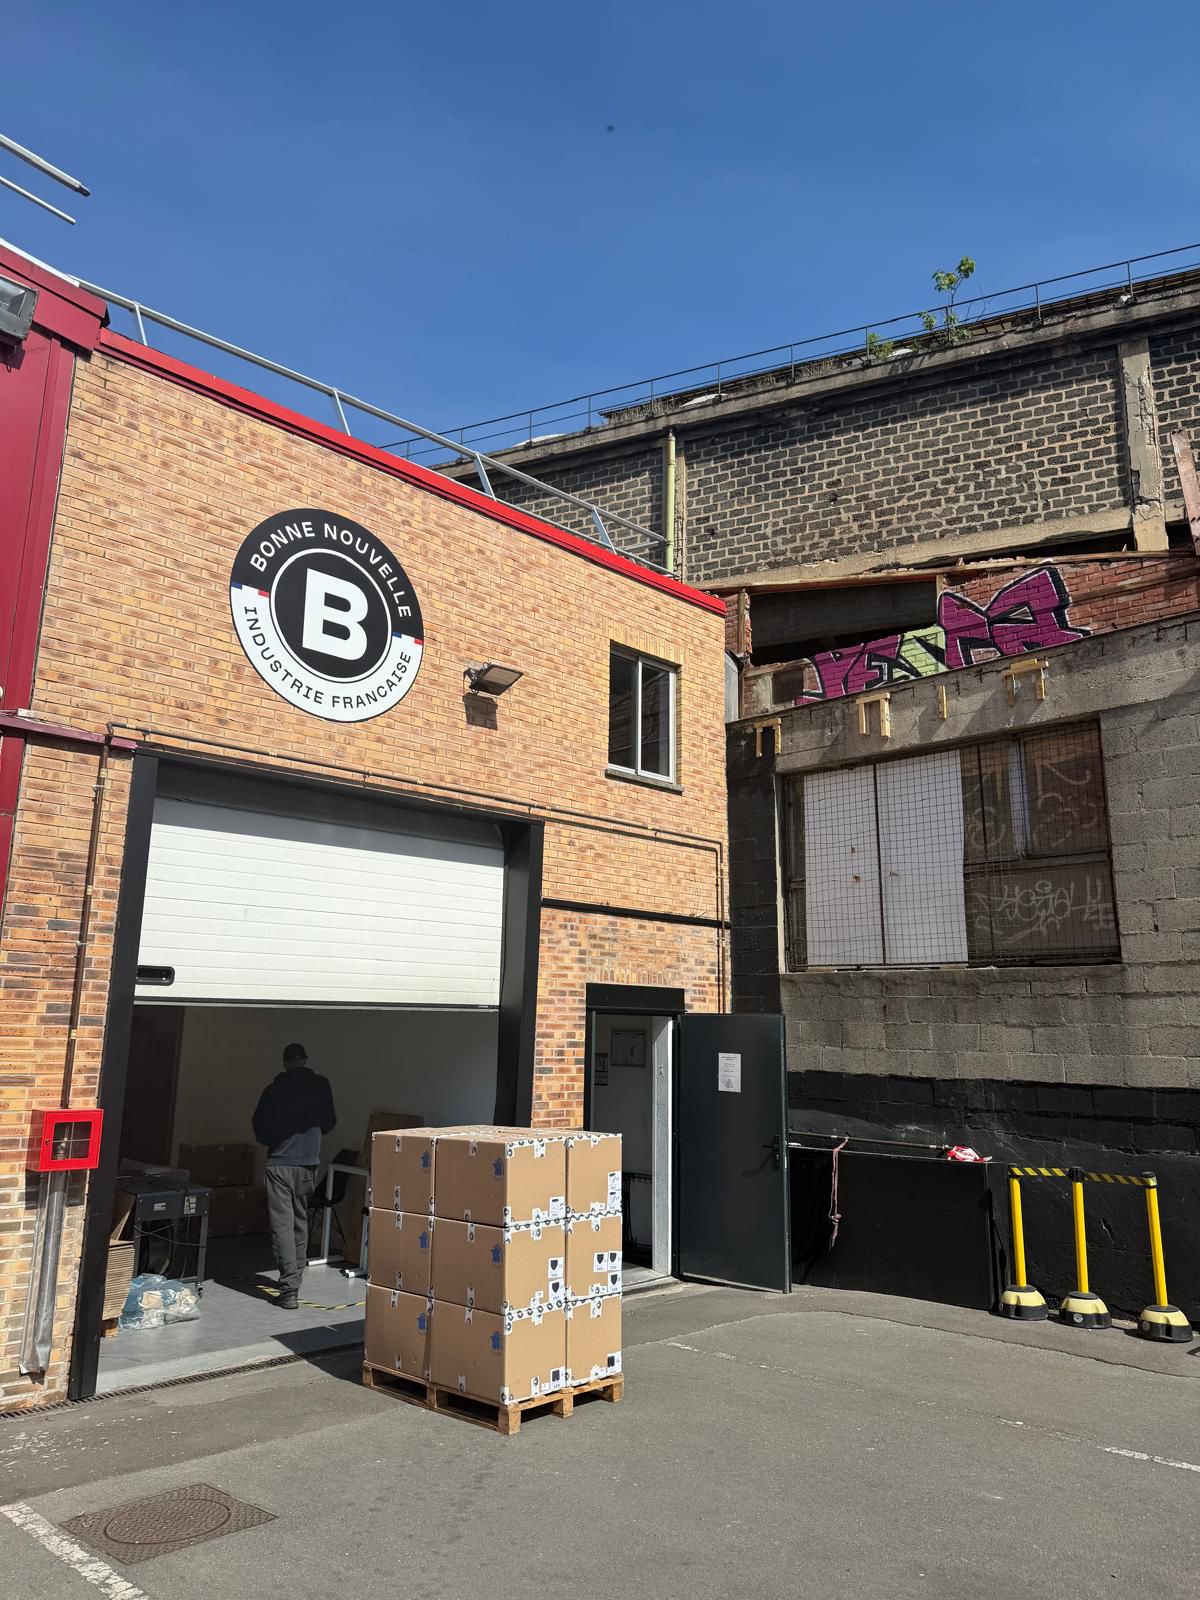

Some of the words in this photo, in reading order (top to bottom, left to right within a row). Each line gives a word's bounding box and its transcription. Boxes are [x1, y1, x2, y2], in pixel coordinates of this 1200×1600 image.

[250, 521, 316, 573] BONNE
[323, 522, 412, 618] NOUVELLE
[302, 568, 369, 661] B
[244, 605, 325, 705] INDUSTRIE
[332, 651, 412, 709] FRANCAISE
